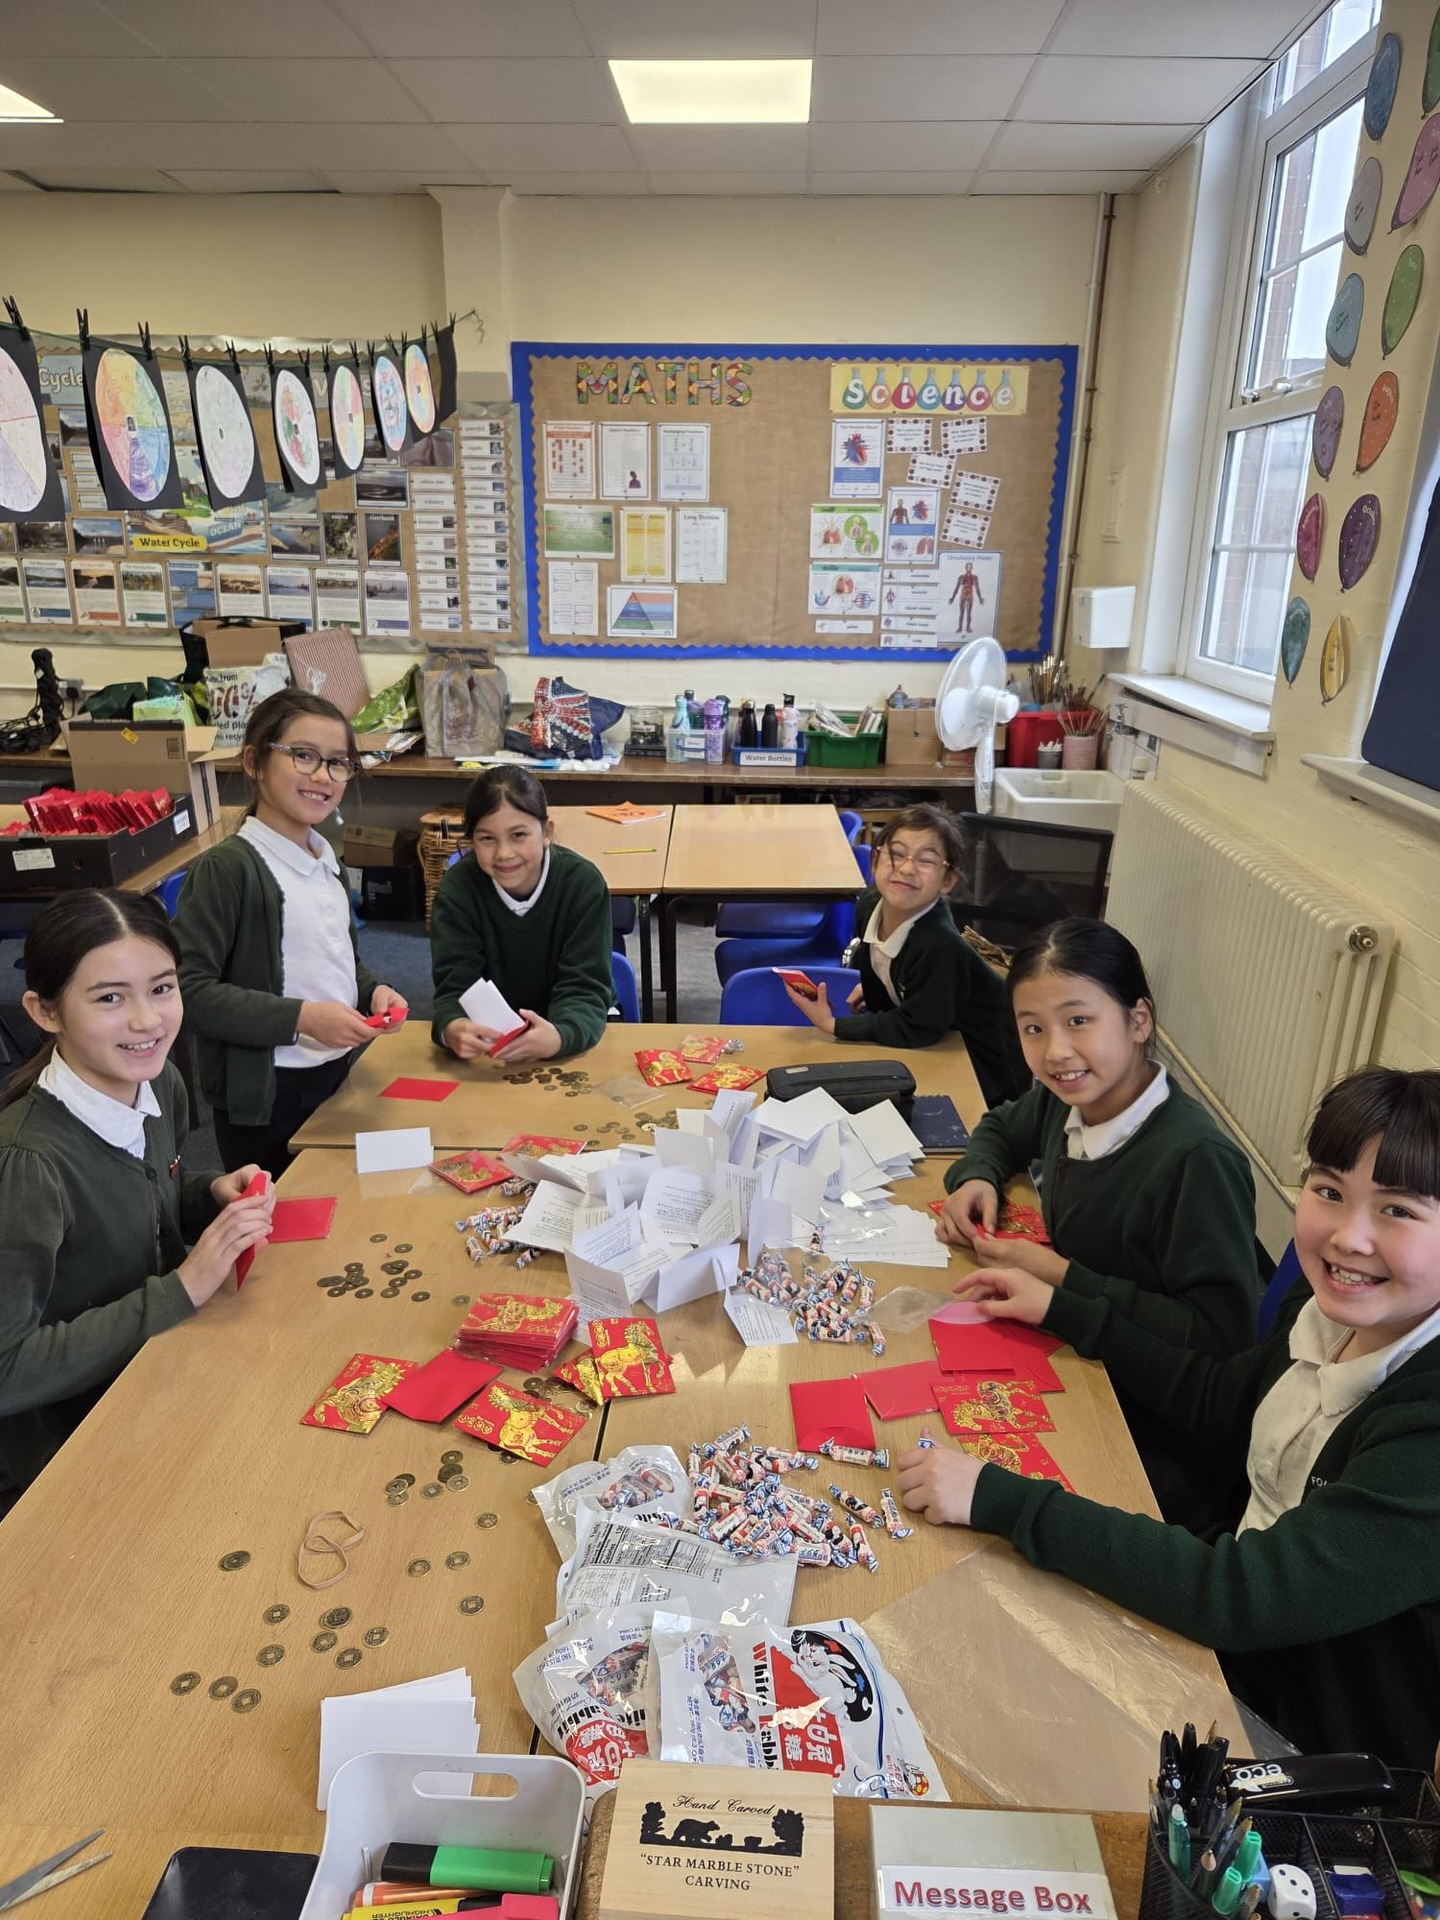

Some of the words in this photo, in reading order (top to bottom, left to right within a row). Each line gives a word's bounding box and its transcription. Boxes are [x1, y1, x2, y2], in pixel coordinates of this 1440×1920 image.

[576, 361, 753, 407] MATHS
[846, 377, 1012, 407] Science
[683, 514, 697, 522] Long
[209, 521, 242, 537] OCEAN
[139, 537, 171, 547] Water
[173, 537, 201, 549] Cycle
[745, 754, 766, 762] Water
[767, 754, 793, 763] Bottles
[752, 1641, 769, 1707] White
[557, 1705, 601, 1740] abbit
[1235, 1763, 1283, 1781] eco
[672, 1795, 720, 1811] Hand
[727, 1798, 776, 1816] Carved
[685, 1858, 743, 1873] MARBLE
[685, 1875, 751, 1891] CARVING
[894, 1880, 1026, 1914] Message
[1034, 1885, 1093, 1914] Box
[371, 1908, 431, 1919] HIGHLIGHTER
